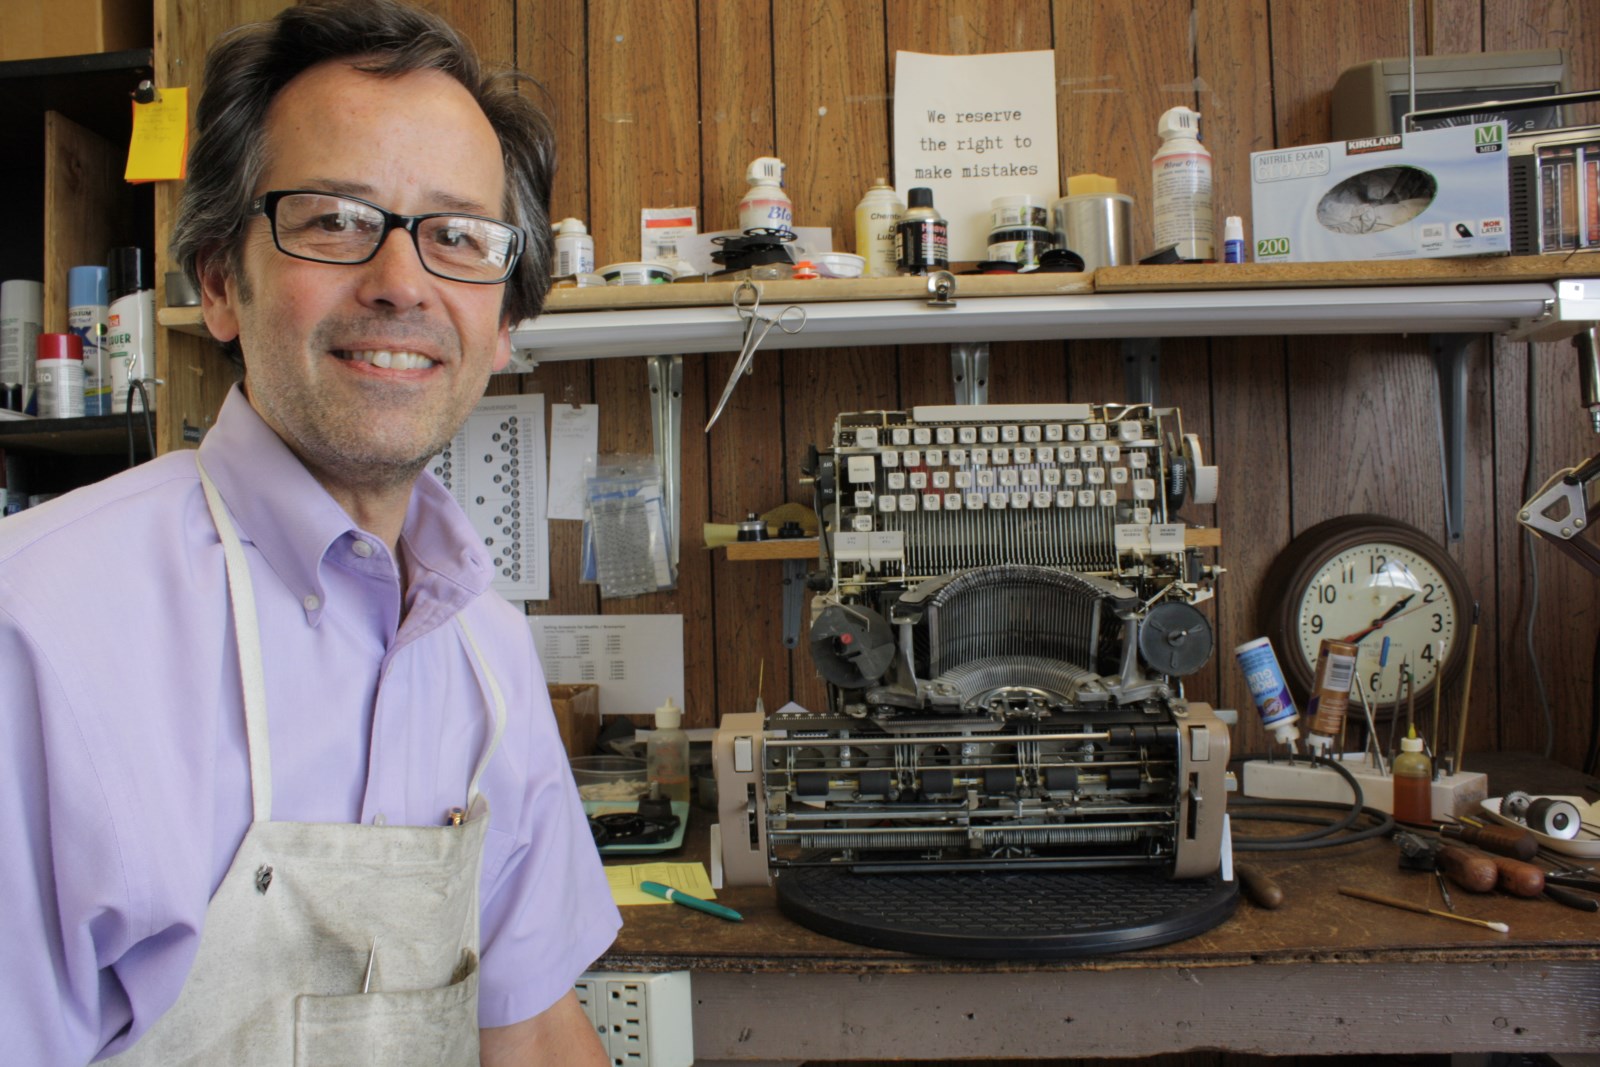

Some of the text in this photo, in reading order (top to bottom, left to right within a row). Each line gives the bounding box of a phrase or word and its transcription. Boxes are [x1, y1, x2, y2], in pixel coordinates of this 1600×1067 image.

[927, 110, 1022, 123] We reserve
[1525, 121, 1535, 129] 2
[1348, 136, 1401, 149] KIRKLAND
[1477, 125, 1499, 144] M
[920, 135, 1032, 154] the right to
[1479, 145, 1498, 153] MED
[1163, 161, 1183, 169] Blow
[1259, 150, 1324, 165] NITRILE EXAM
[915, 163, 1038, 179] make mistakes
[1258, 160, 1327, 180] GLOVES
[1483, 220, 1500, 228] NON
[1258, 238, 1289, 255] 200
[1341, 564, 1354, 584] 11
[1370, 555, 1387, 575] 12
[1318, 584, 1337, 604] 10
[1422, 584, 1435, 603] 2
[1311, 615, 1323, 634] 9
[1431, 613, 1443, 633] 3
[1420, 644, 1434, 663] 4
[1370, 672, 1382, 692] 6
